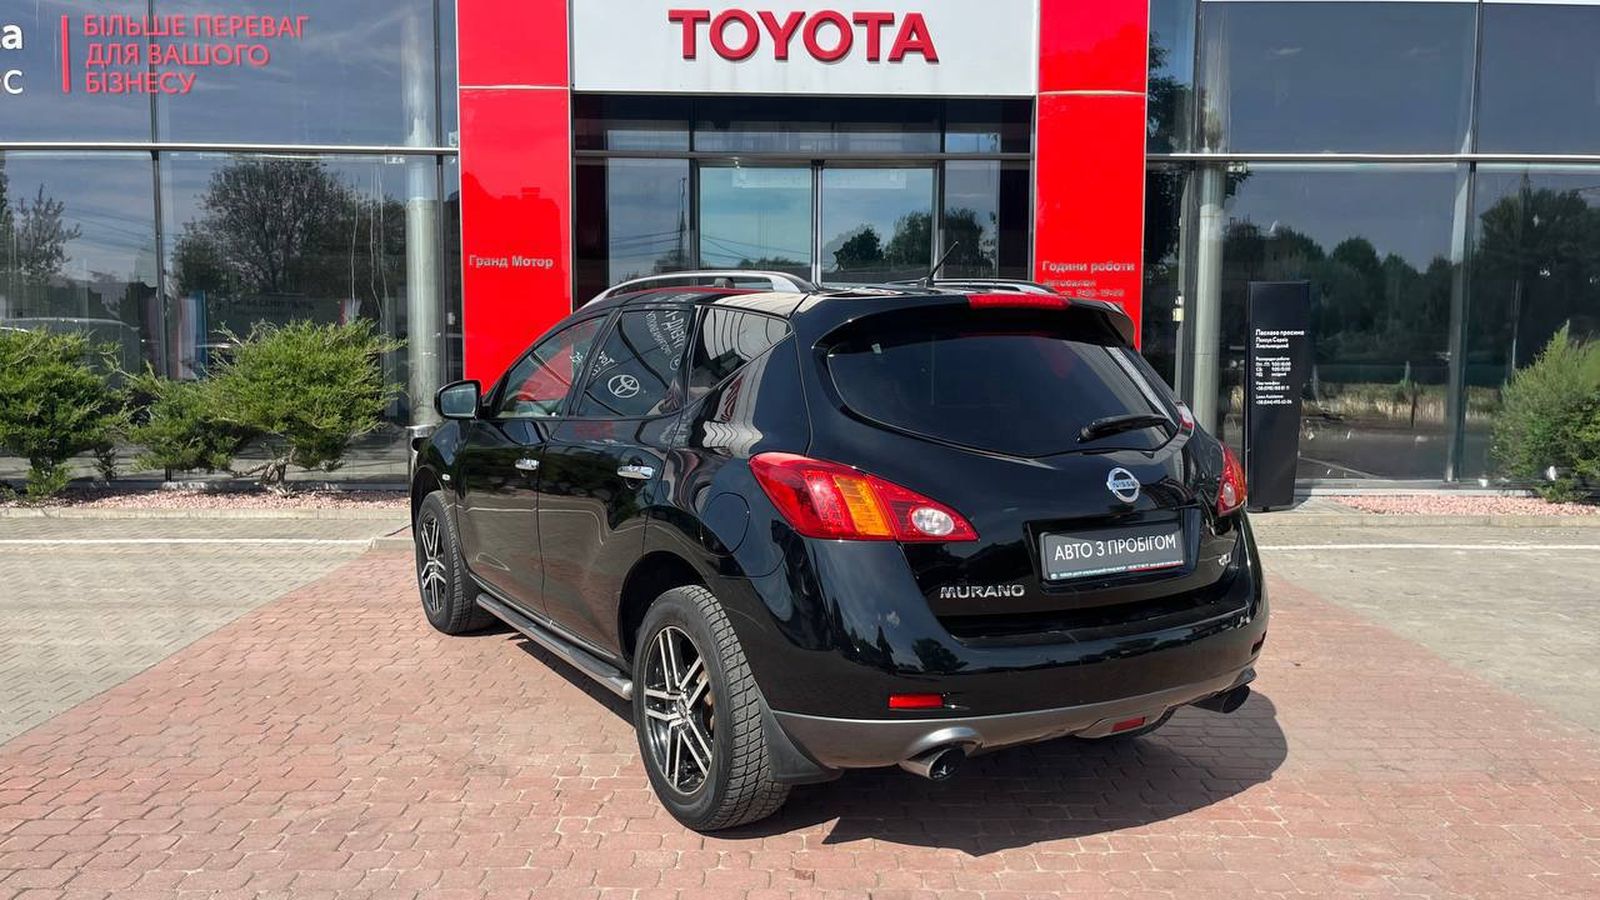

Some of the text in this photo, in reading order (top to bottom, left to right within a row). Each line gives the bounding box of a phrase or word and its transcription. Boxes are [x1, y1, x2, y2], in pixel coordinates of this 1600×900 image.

[83, 14, 309, 39] БІЛЬШЕ ПЕРЕВАГ
[668, 9, 939, 63] TOYOTA
[86, 44, 271, 69] ДЛЯ ВАШОГО
[86, 72, 197, 95] БІЗНЕСУ
[469, 254, 554, 269] Гранд Мотор
[1042, 261, 1135, 274] Години роботи
[1055, 541, 1093, 561] АВТО
[1107, 534, 1177, 555] ПРОБІГОМ
[940, 584, 1025, 600] MURANO
